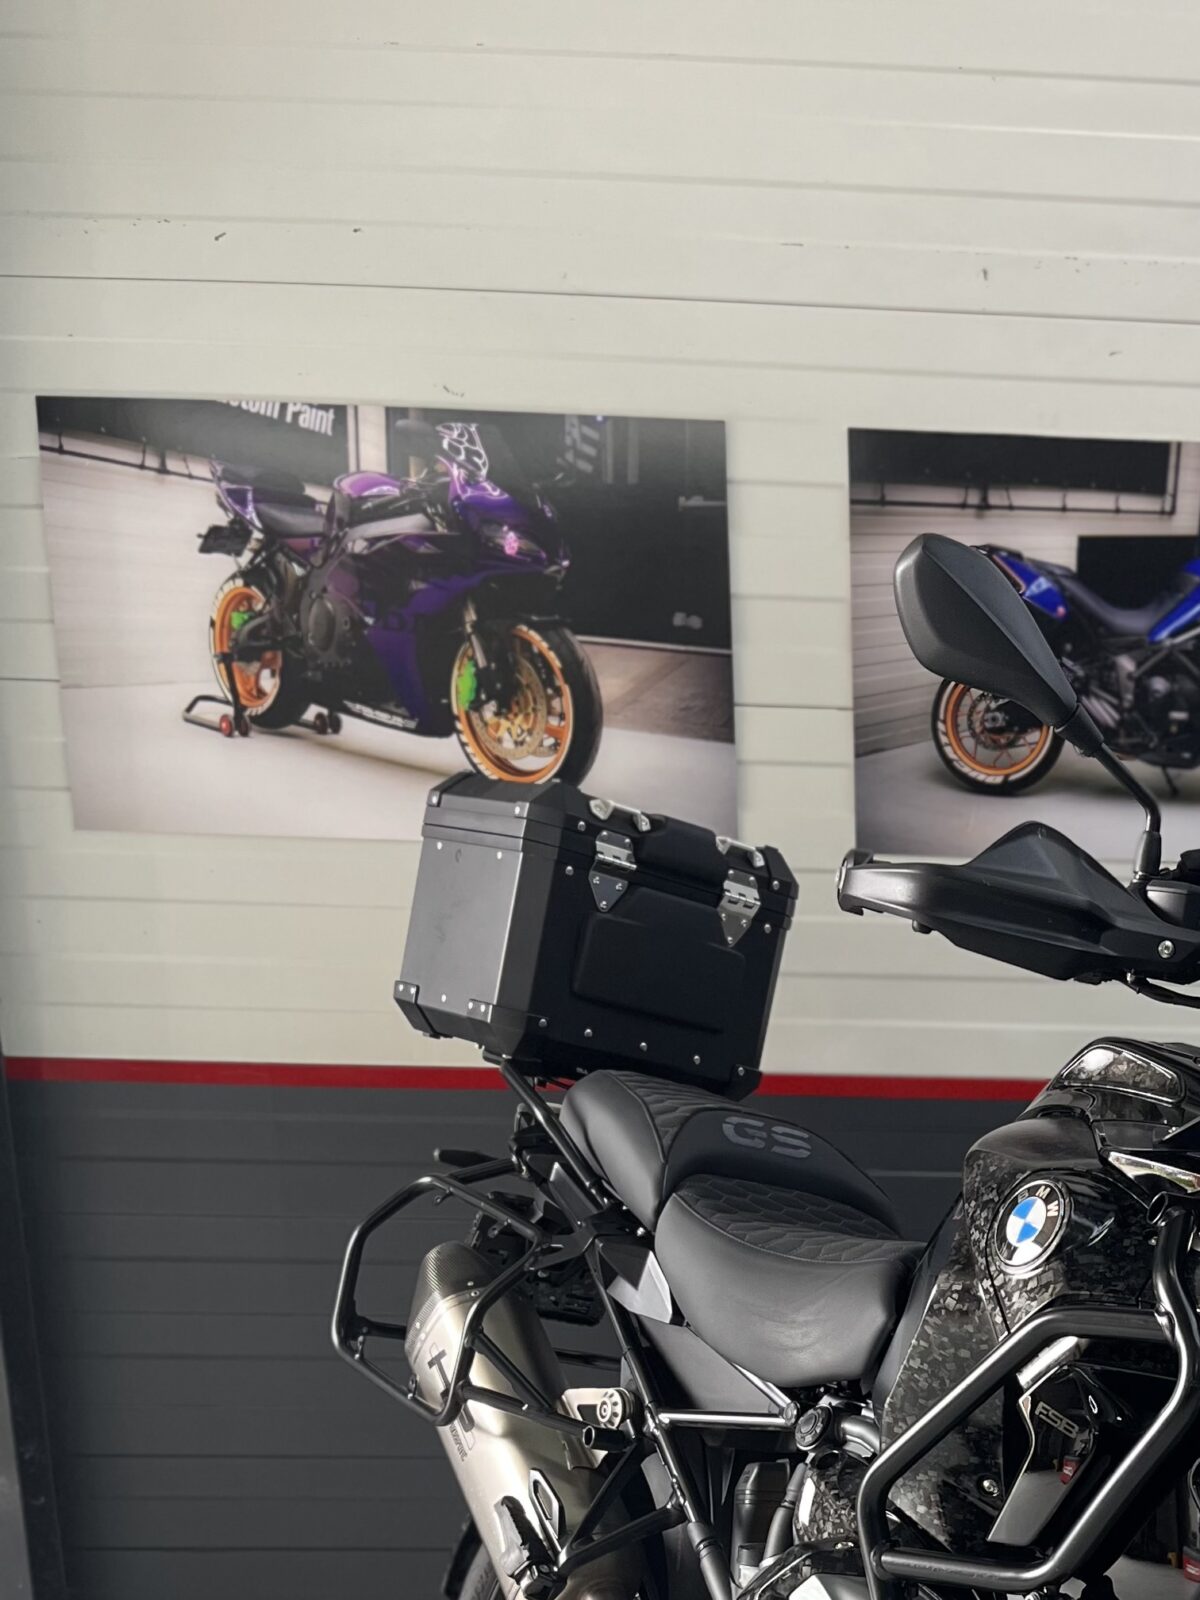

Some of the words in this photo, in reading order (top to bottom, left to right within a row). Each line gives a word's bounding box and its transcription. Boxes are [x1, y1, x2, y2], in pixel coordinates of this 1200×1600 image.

[722, 1116, 812, 1159] GS
[1017, 1185, 1060, 1218] BMW
[1034, 1401, 1080, 1439] FSB
